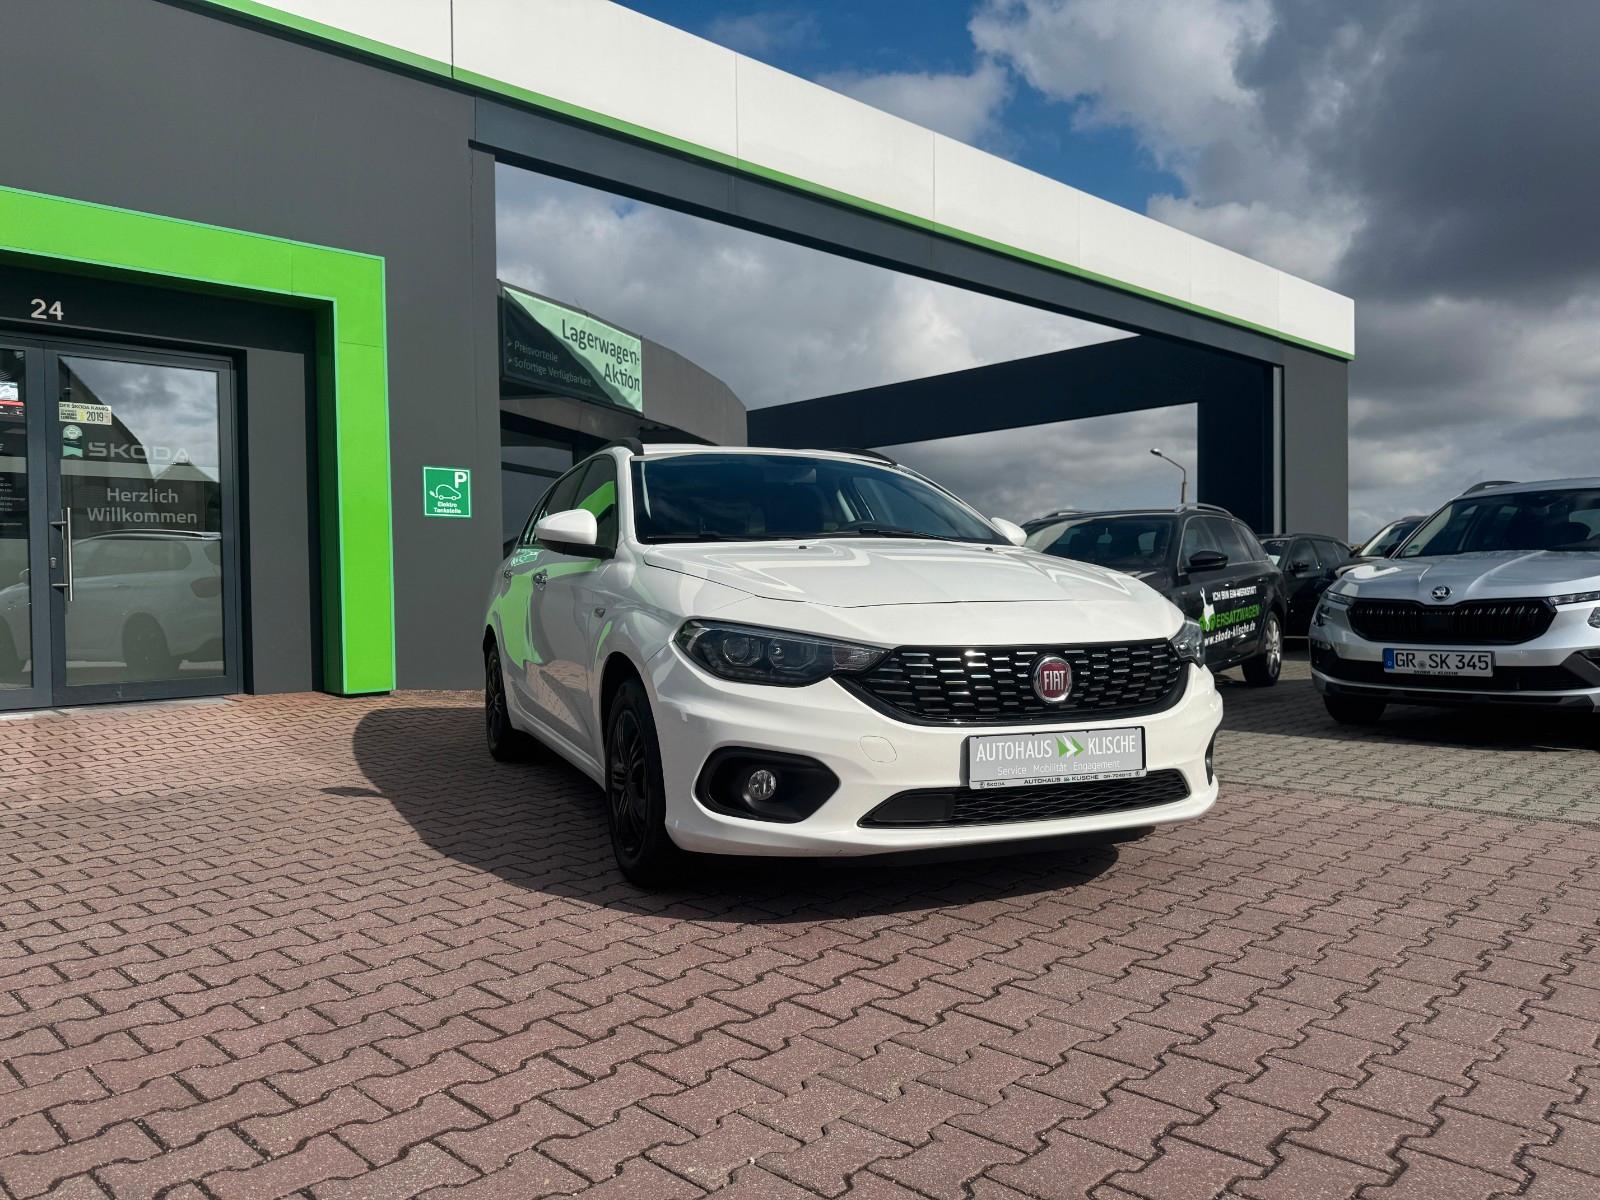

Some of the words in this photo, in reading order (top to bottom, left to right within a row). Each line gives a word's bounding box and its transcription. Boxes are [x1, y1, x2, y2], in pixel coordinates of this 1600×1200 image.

[30, 298, 64, 321] 24
[562, 319, 640, 365] Lagerwagen-
[514, 357, 547, 377] Sofortige
[604, 363, 640, 392] Aktion
[86, 411, 104, 422] 2019
[455, 471, 467, 489] P
[107, 487, 179, 504] Herzlich
[87, 507, 198, 525] Willkommen
[1216, 603, 1260, 628] ERSATZWAGEN
[1204, 620, 1256, 647] ww.skoda-klische.de
[1395, 652, 1416, 669] GR
[1428, 653, 1451, 670] SK
[1455, 654, 1489, 671] 345
[1043, 670, 1066, 691] FIAT
[976, 740, 1052, 762] AUTOHAUS
[1088, 735, 1137, 755] KLISCHE
[997, 766, 1027, 776] Service
[1033, 762, 1067, 774] Mobilität
[1073, 760, 1121, 772] Engagement
[1024, 777, 1061, 785] AUTOHAUS
